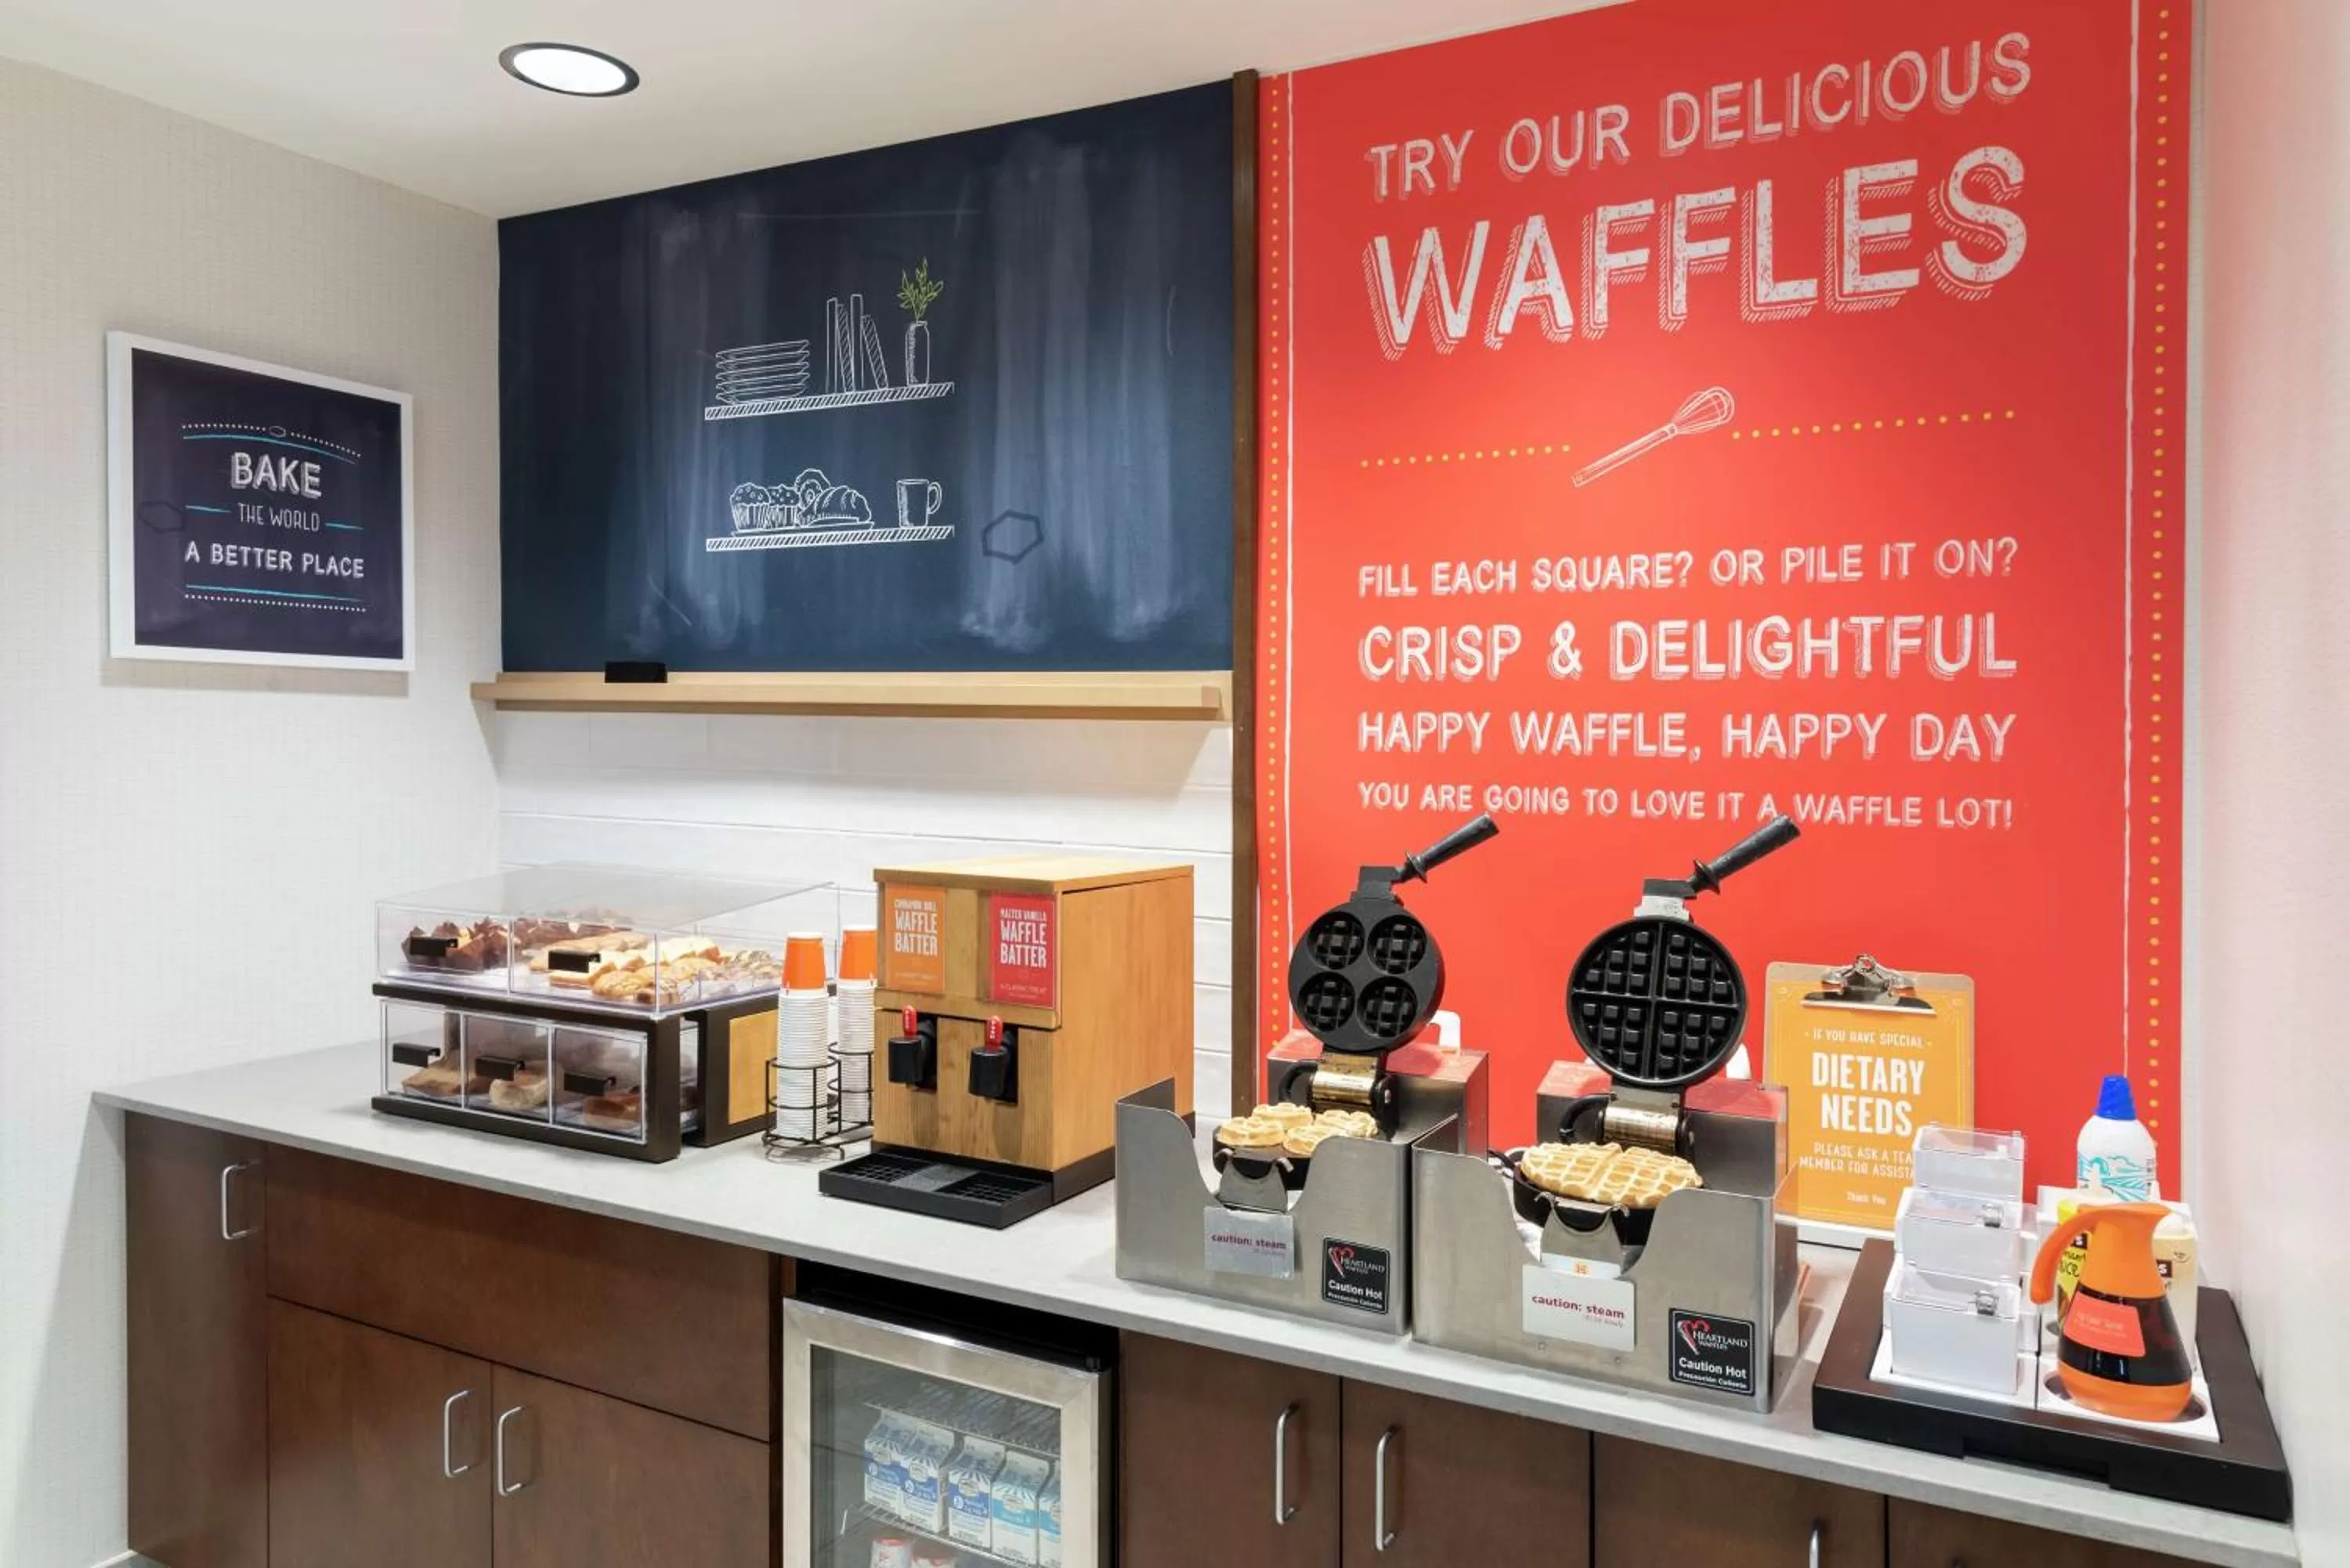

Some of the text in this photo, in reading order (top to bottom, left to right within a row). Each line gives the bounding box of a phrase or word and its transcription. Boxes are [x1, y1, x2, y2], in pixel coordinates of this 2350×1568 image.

[1365, 31, 2032, 201] TRY OUR DELICIOUS
[1363, 145, 2028, 360] WAFFLES
[230, 452, 322, 498] BAKE
[238, 503, 320, 531] THE WORLD
[184, 540, 364, 578] A BETTER PLACE
[1359, 537, 2018, 597] FILL EACH SQUARE? OR PILE IT ON?
[1360, 613, 2016, 682] CRISP & DELIGHTFUL
[1359, 710, 2016, 763] HAPPY WAFFLE, HAPPY DAY
[1360, 782, 2012, 828] YOU ARE GOING TO LOVE IT A WAFFLE LOT!
[895, 909, 938, 934] WAFFLE
[1000, 919, 1047, 945] WAFFLE
[895, 933, 938, 956] BATTER
[1000, 942, 1047, 968] BATTER
[1813, 1028, 1923, 1048] IF YOU HAVE SPECIAL
[1812, 1052, 1925, 1095] DIETARY
[1821, 1093, 1913, 1136] NEEDS
[1799, 1156, 1843, 1172] MEMBER
[1848, 1160, 1867, 1174] FOR
[1813, 1142, 1853, 1158] PLEASE
[1858, 1147, 1877, 1160] ASK
[1882, 1149, 1889, 1163] A
[1212, 1234, 1286, 1250] caution: steam
[1329, 1279, 1383, 1300] Caution Hot
[1532, 1295, 1625, 1319] caution: steam
[1679, 1357, 1746, 1379] Caution Hot
